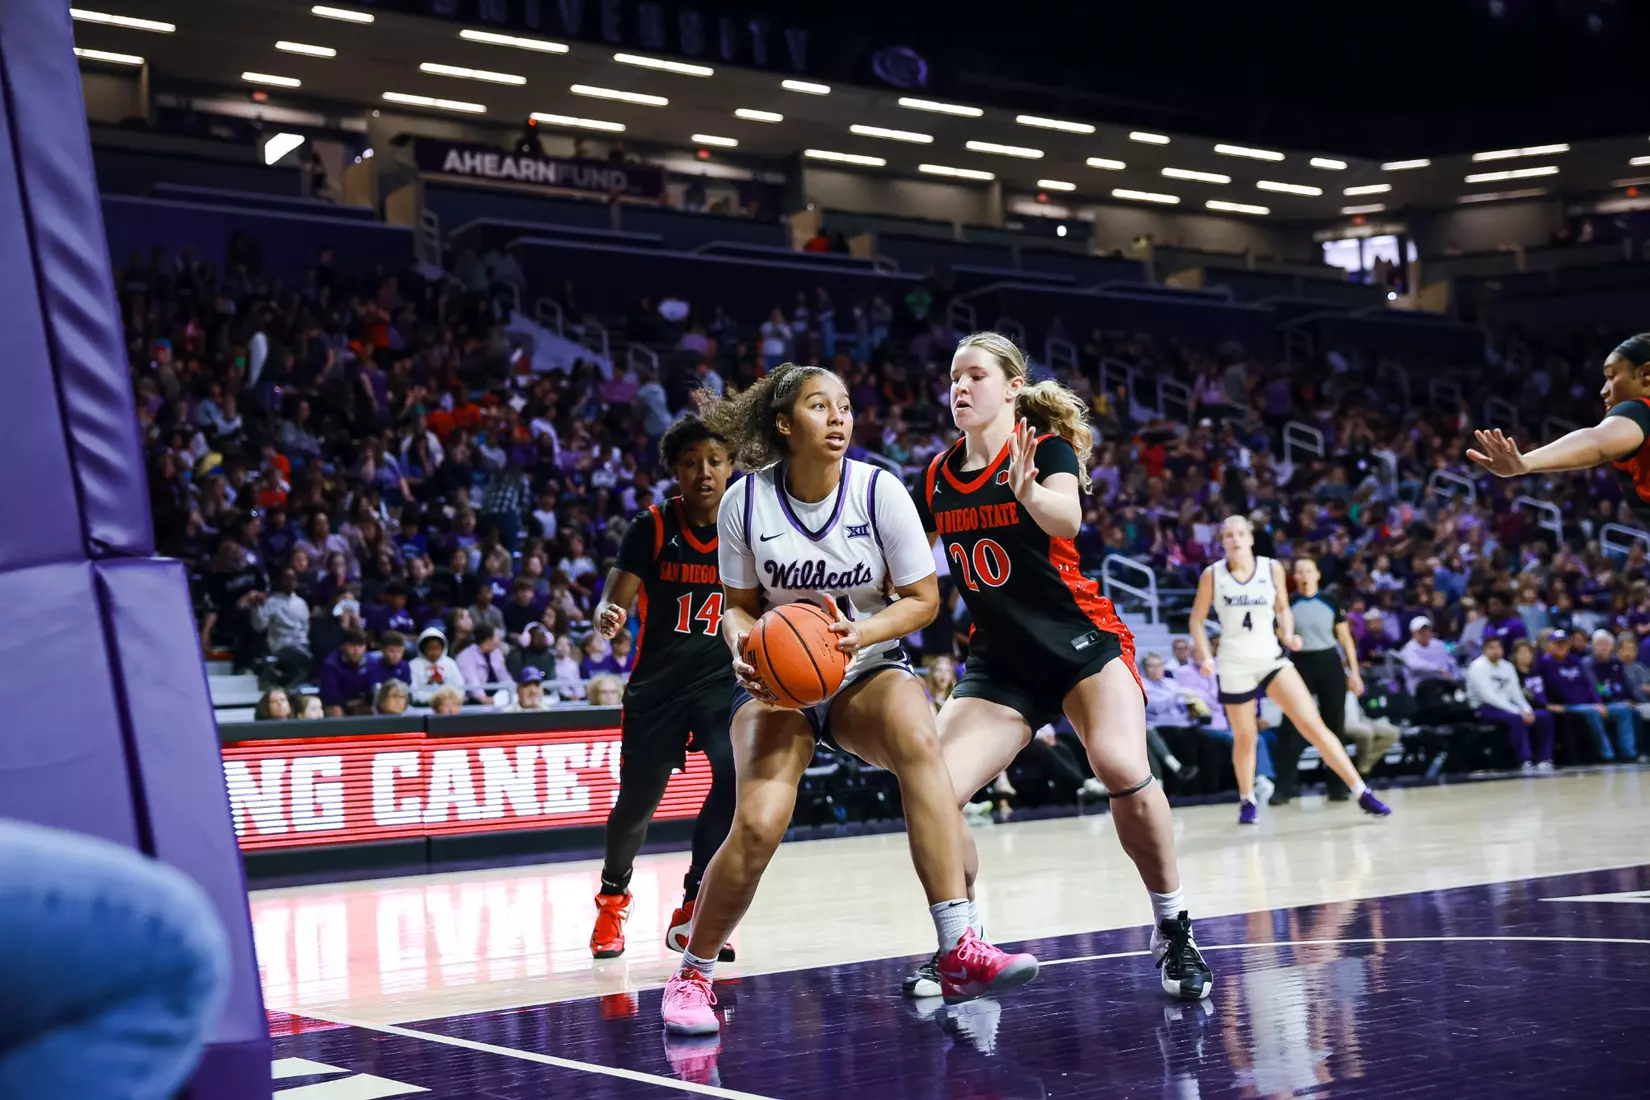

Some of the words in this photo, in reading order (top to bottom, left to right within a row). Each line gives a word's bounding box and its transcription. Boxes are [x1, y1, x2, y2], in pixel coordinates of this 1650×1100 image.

[945, 507, 978, 534] DIEGO
[980, 502, 1019, 529] STATE
[660, 562, 679, 582] SAN
[681, 563, 717, 584] DIEGO
[764, 559, 873, 590] Wildcats
[949, 538, 1011, 592] 20
[674, 592, 723, 636] 14
[1243, 611, 1253, 632] 4
